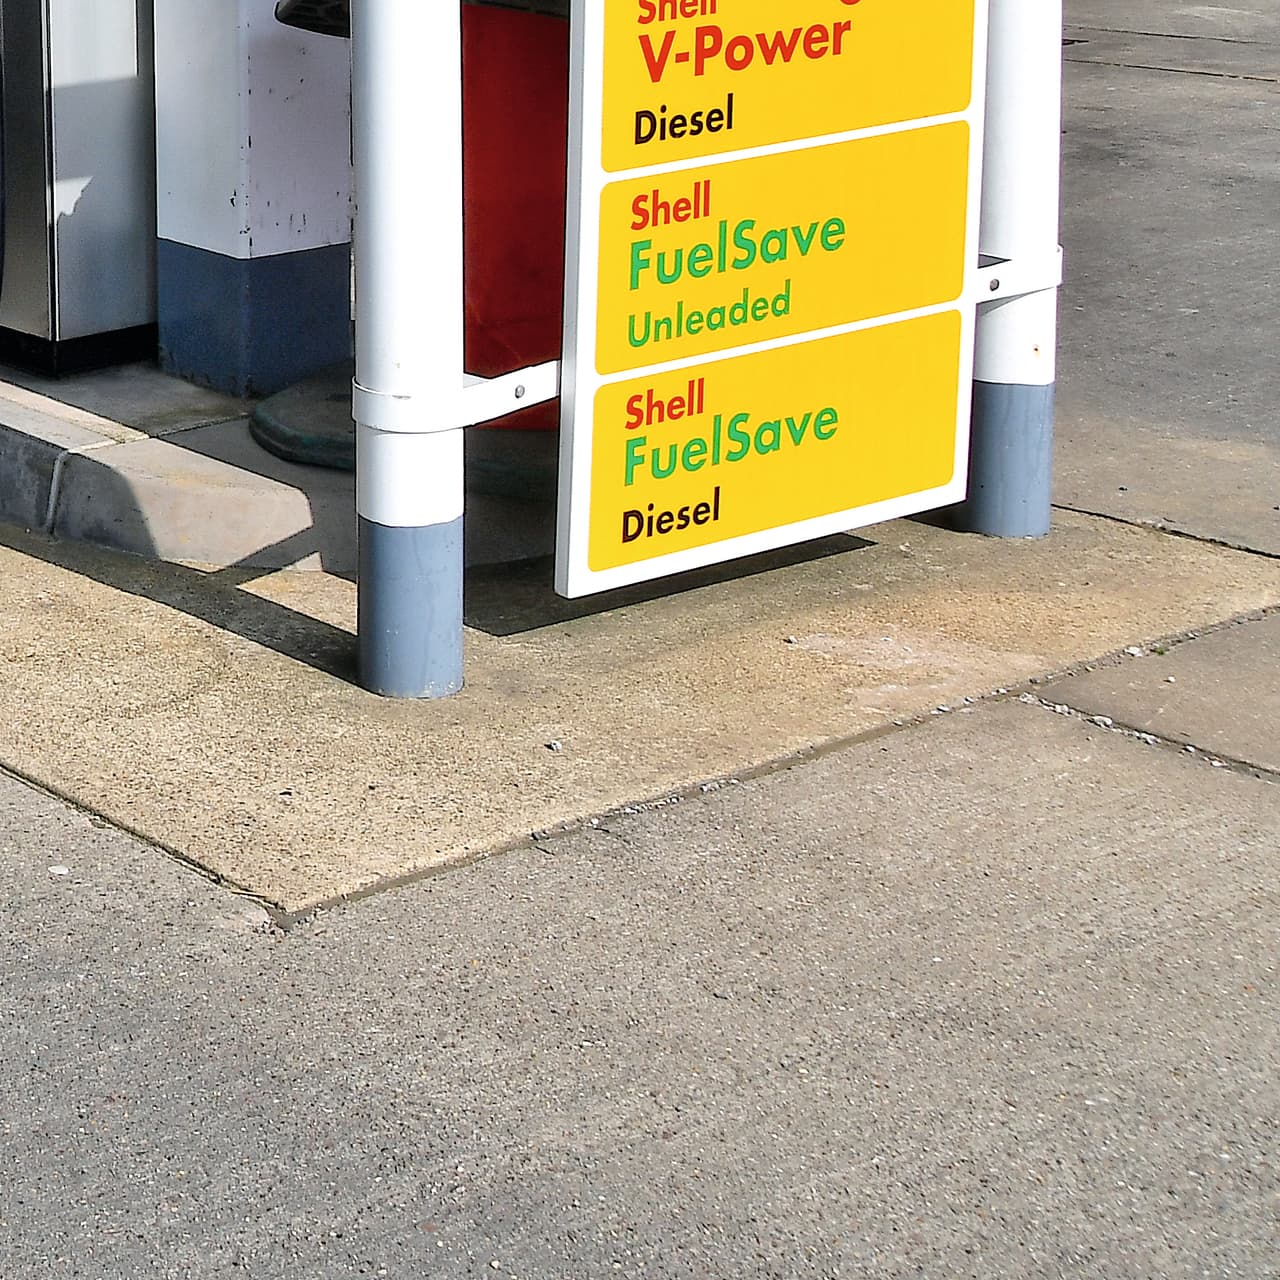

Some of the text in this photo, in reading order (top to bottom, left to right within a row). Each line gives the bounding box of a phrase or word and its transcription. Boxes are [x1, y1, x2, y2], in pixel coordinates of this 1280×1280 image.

[639, 18, 852, 83] V-Power
[634, 93, 734, 145] Diesel
[630, 179, 711, 231] Shell
[628, 216, 846, 290] FuelSave
[627, 279, 792, 348] Unleaded
[624, 378, 705, 430] Shell
[623, 406, 840, 487] FuelSave
[621, 487, 721, 544] Diesel
